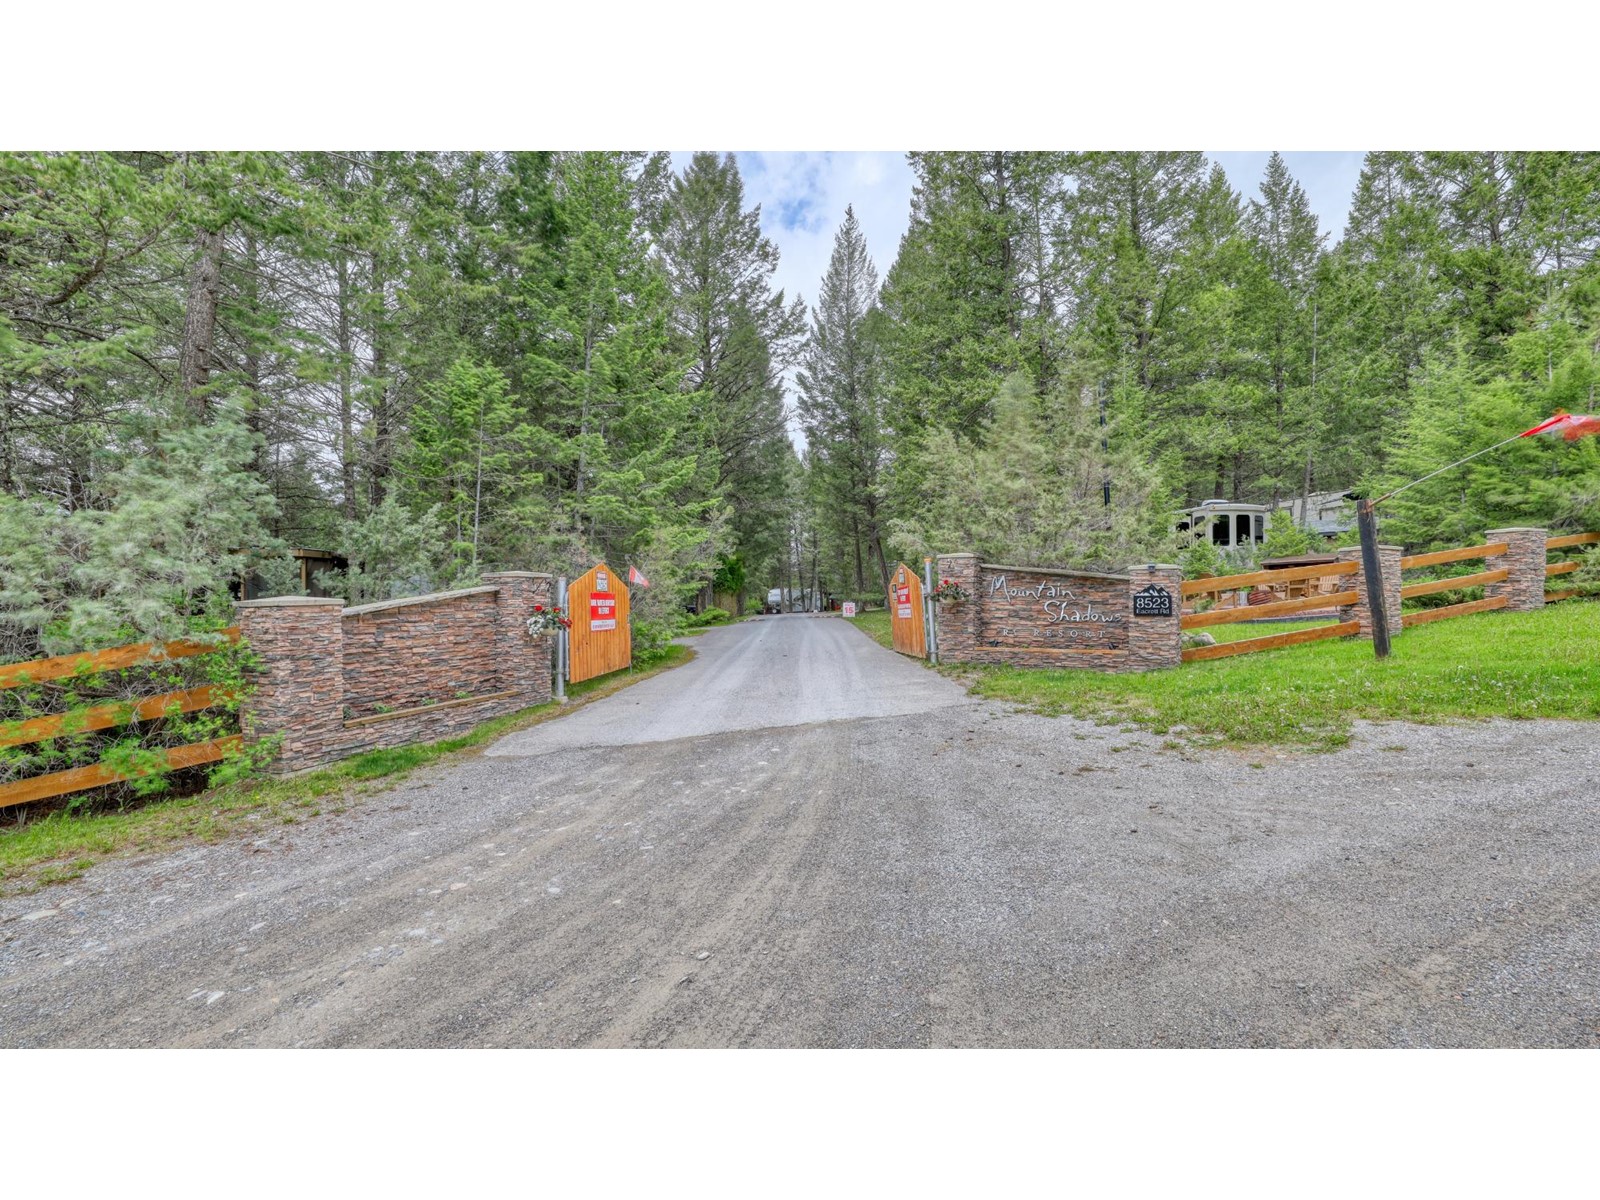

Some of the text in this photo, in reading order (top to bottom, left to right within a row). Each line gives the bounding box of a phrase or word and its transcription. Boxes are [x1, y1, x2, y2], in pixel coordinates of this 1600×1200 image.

[990, 575, 1076, 602] Mountain
[1044, 600, 1122, 622] Shadows
[1136, 597, 1169, 609] 8523
[1033, 629, 1106, 638] RESORT
